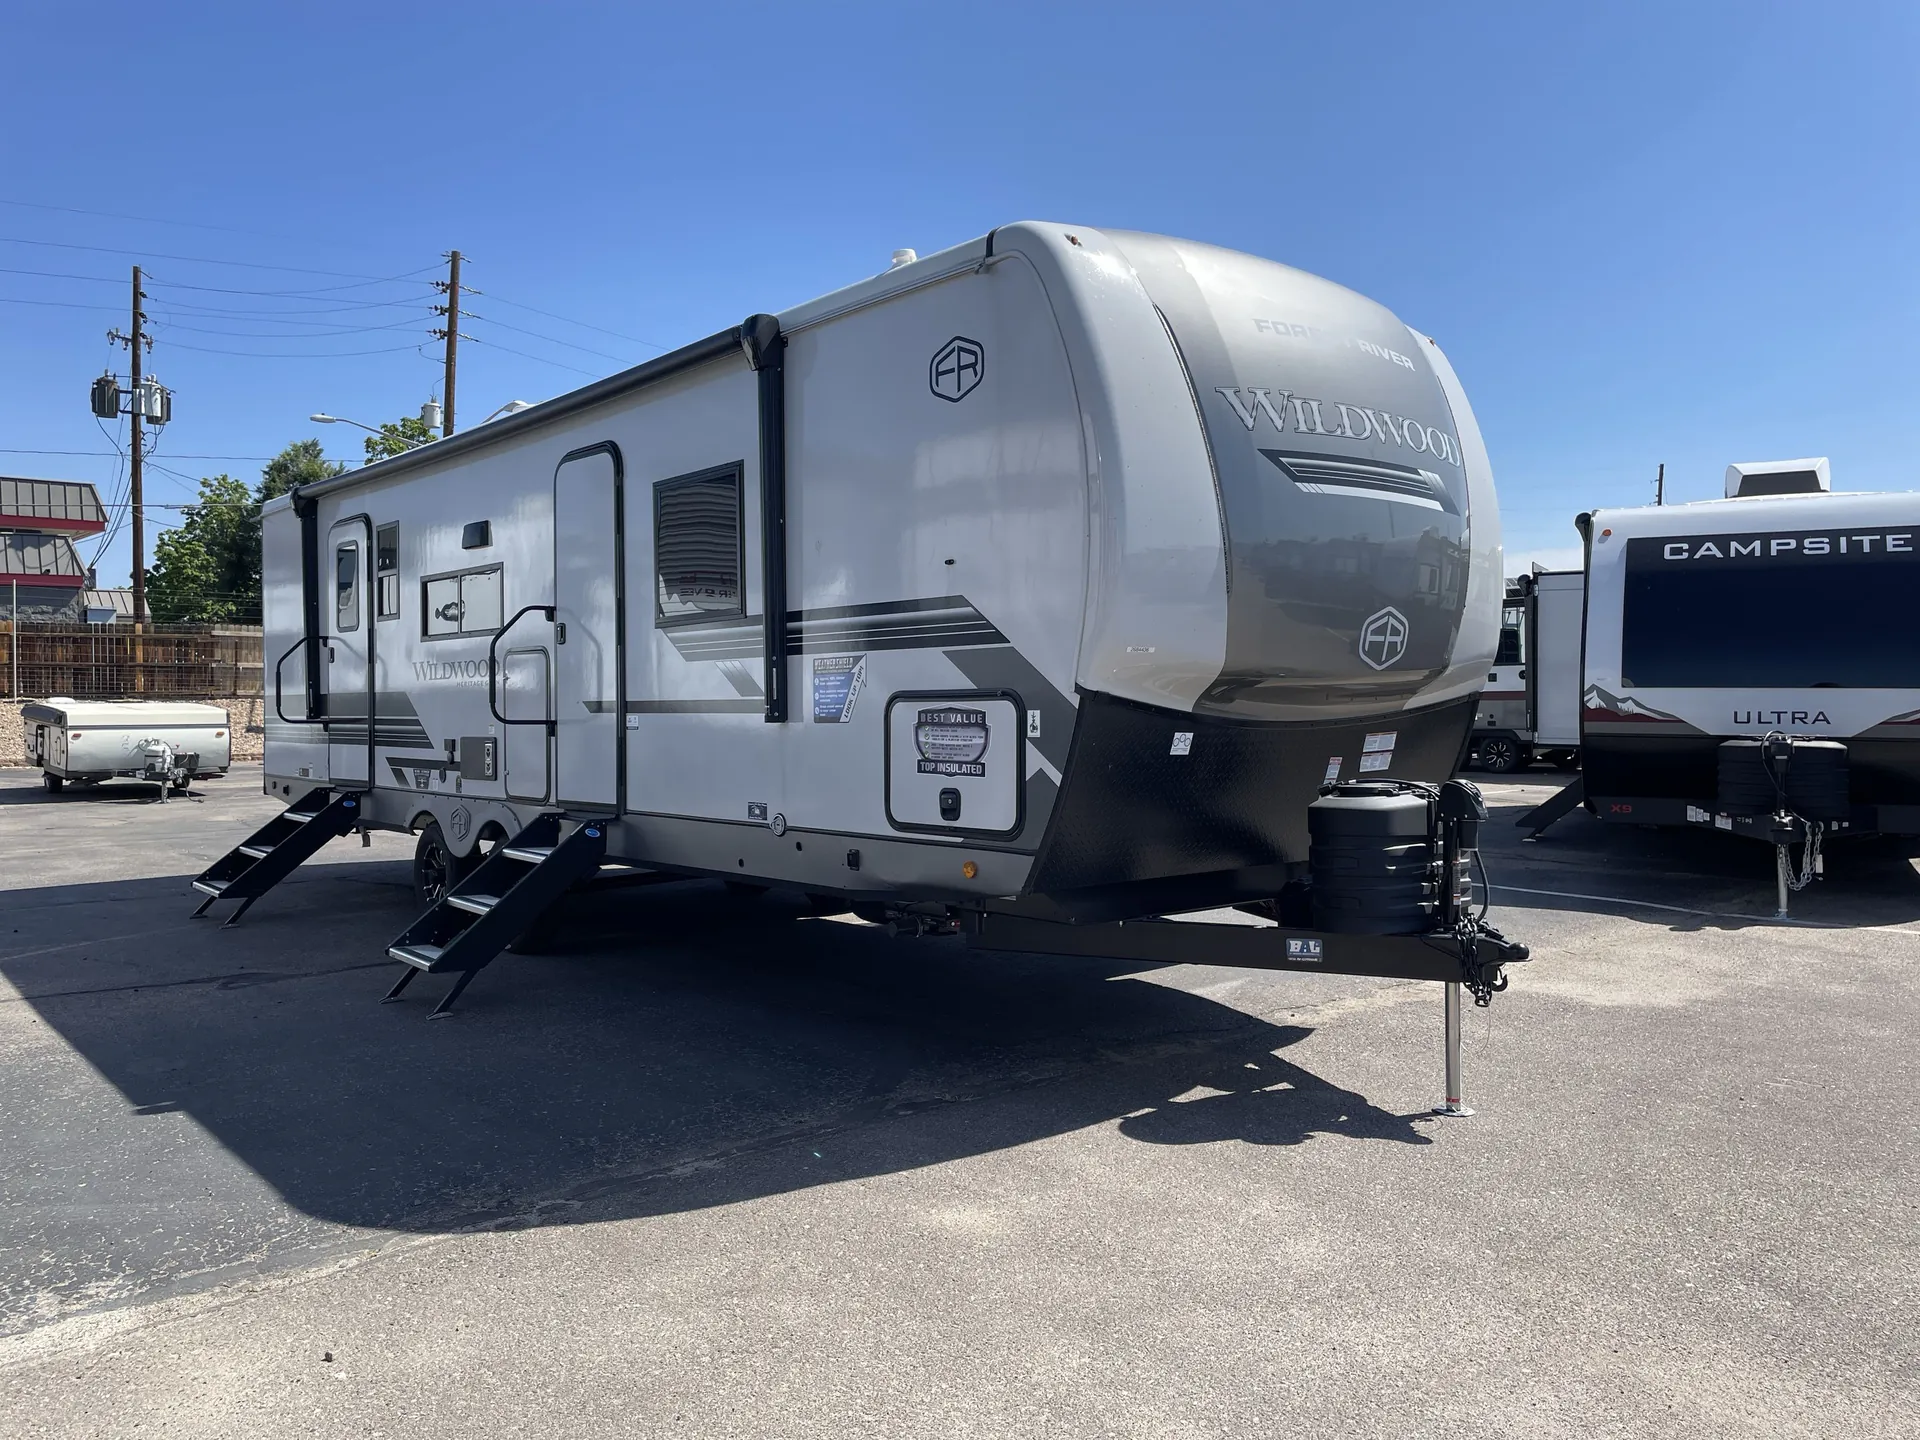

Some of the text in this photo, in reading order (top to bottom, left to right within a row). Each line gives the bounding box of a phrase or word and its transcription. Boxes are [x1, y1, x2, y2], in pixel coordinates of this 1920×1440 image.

[1356, 337, 1416, 371] RIVER
[1214, 386, 1461, 468] WILDWOOD
[1663, 533, 1913, 560] CAMPSITE
[844, 699, 854, 718] LOOK
[920, 713, 983, 724] BEST VALUE
[1733, 710, 1832, 725] ULTRA
[920, 761, 982, 775] TOP INSULATED
[1610, 804, 1632, 813] X9
